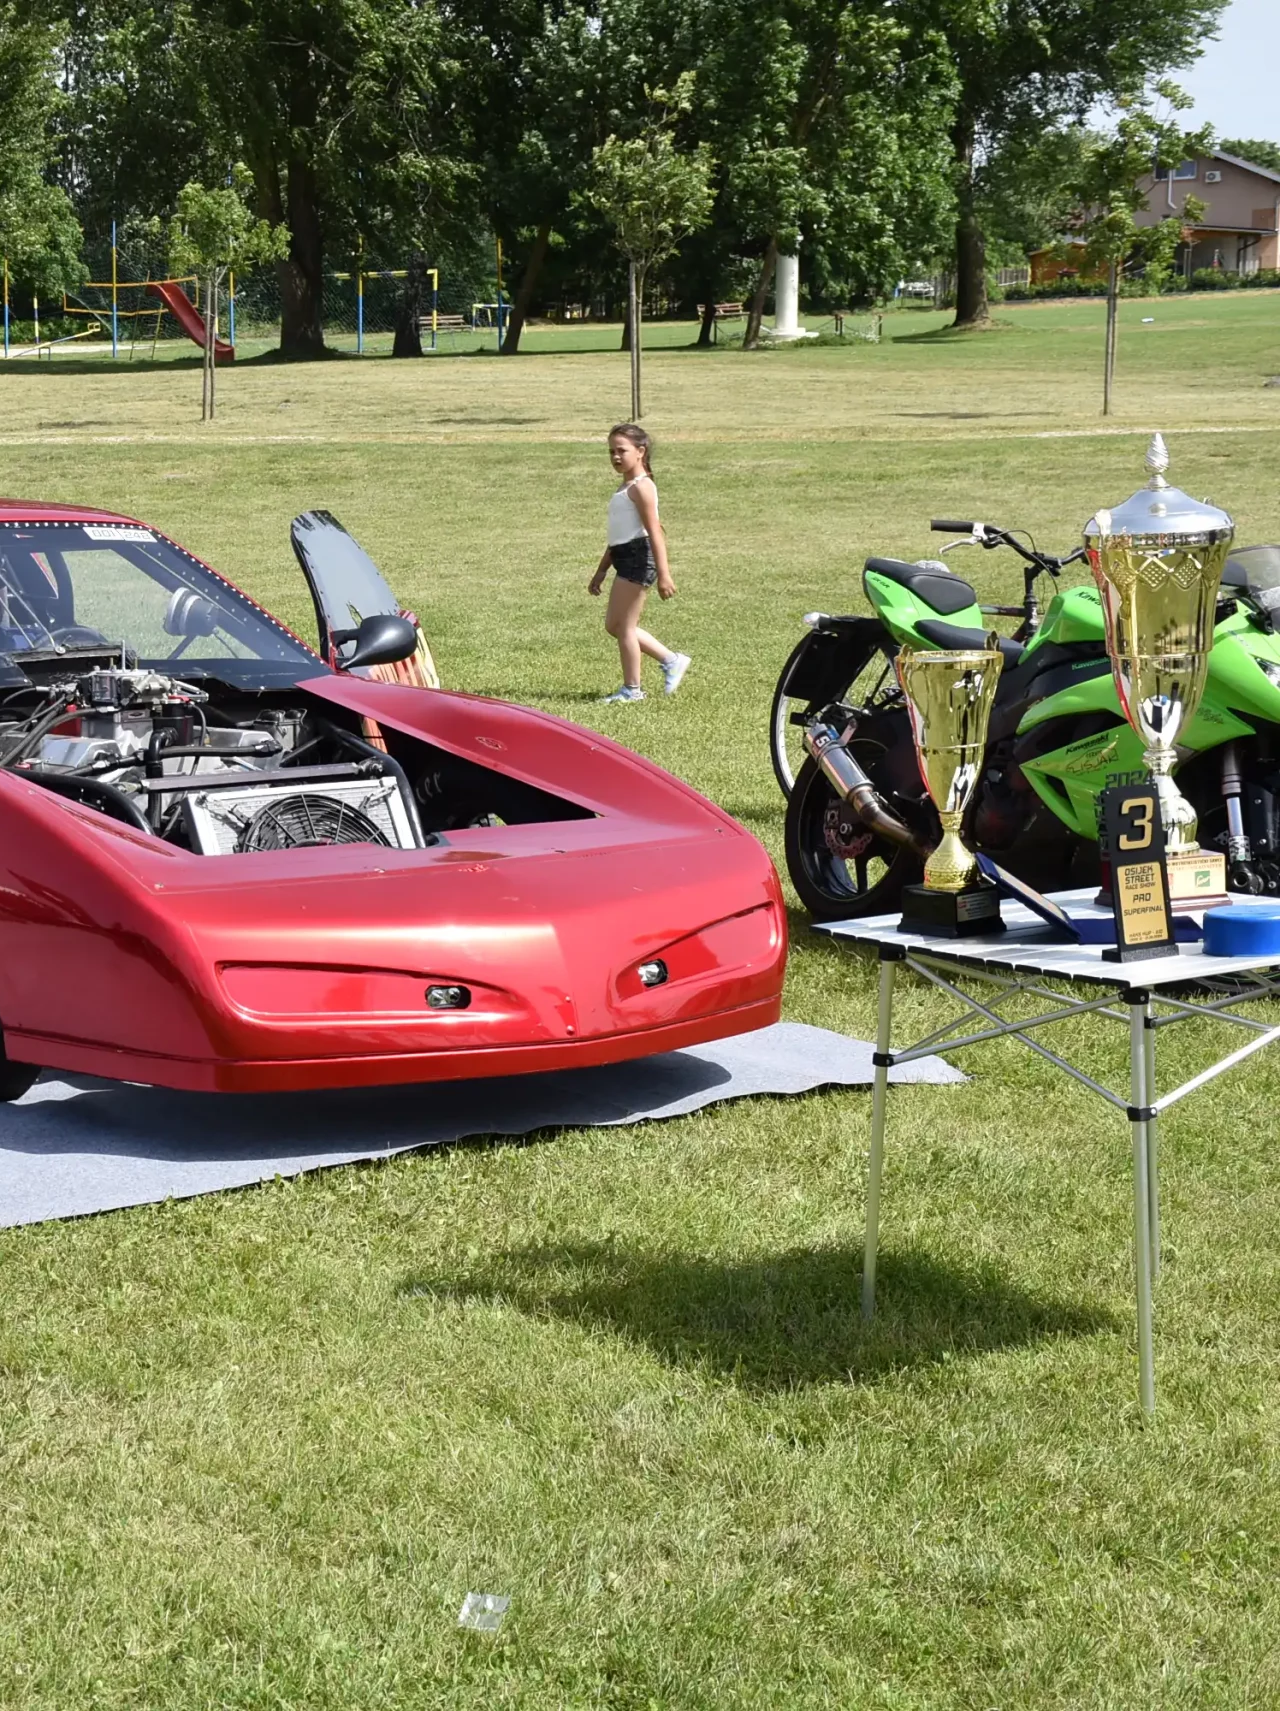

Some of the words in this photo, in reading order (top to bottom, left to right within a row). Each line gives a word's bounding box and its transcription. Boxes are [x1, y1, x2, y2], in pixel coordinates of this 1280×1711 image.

[91, 529, 116, 537] 001
[1075, 591, 1101, 605] Kawa
[1071, 656, 1110, 670] Kawasak
[1105, 769, 1155, 788] 2024
[1119, 797, 1154, 850] 3
[1125, 866, 1153, 876] OSIJEK
[1125, 873, 1155, 885] STREET
[1139, 881, 1156, 889] SHOW
[1132, 892, 1151, 903] PRO
[1123, 905, 1163, 916] SUPERFINAL
